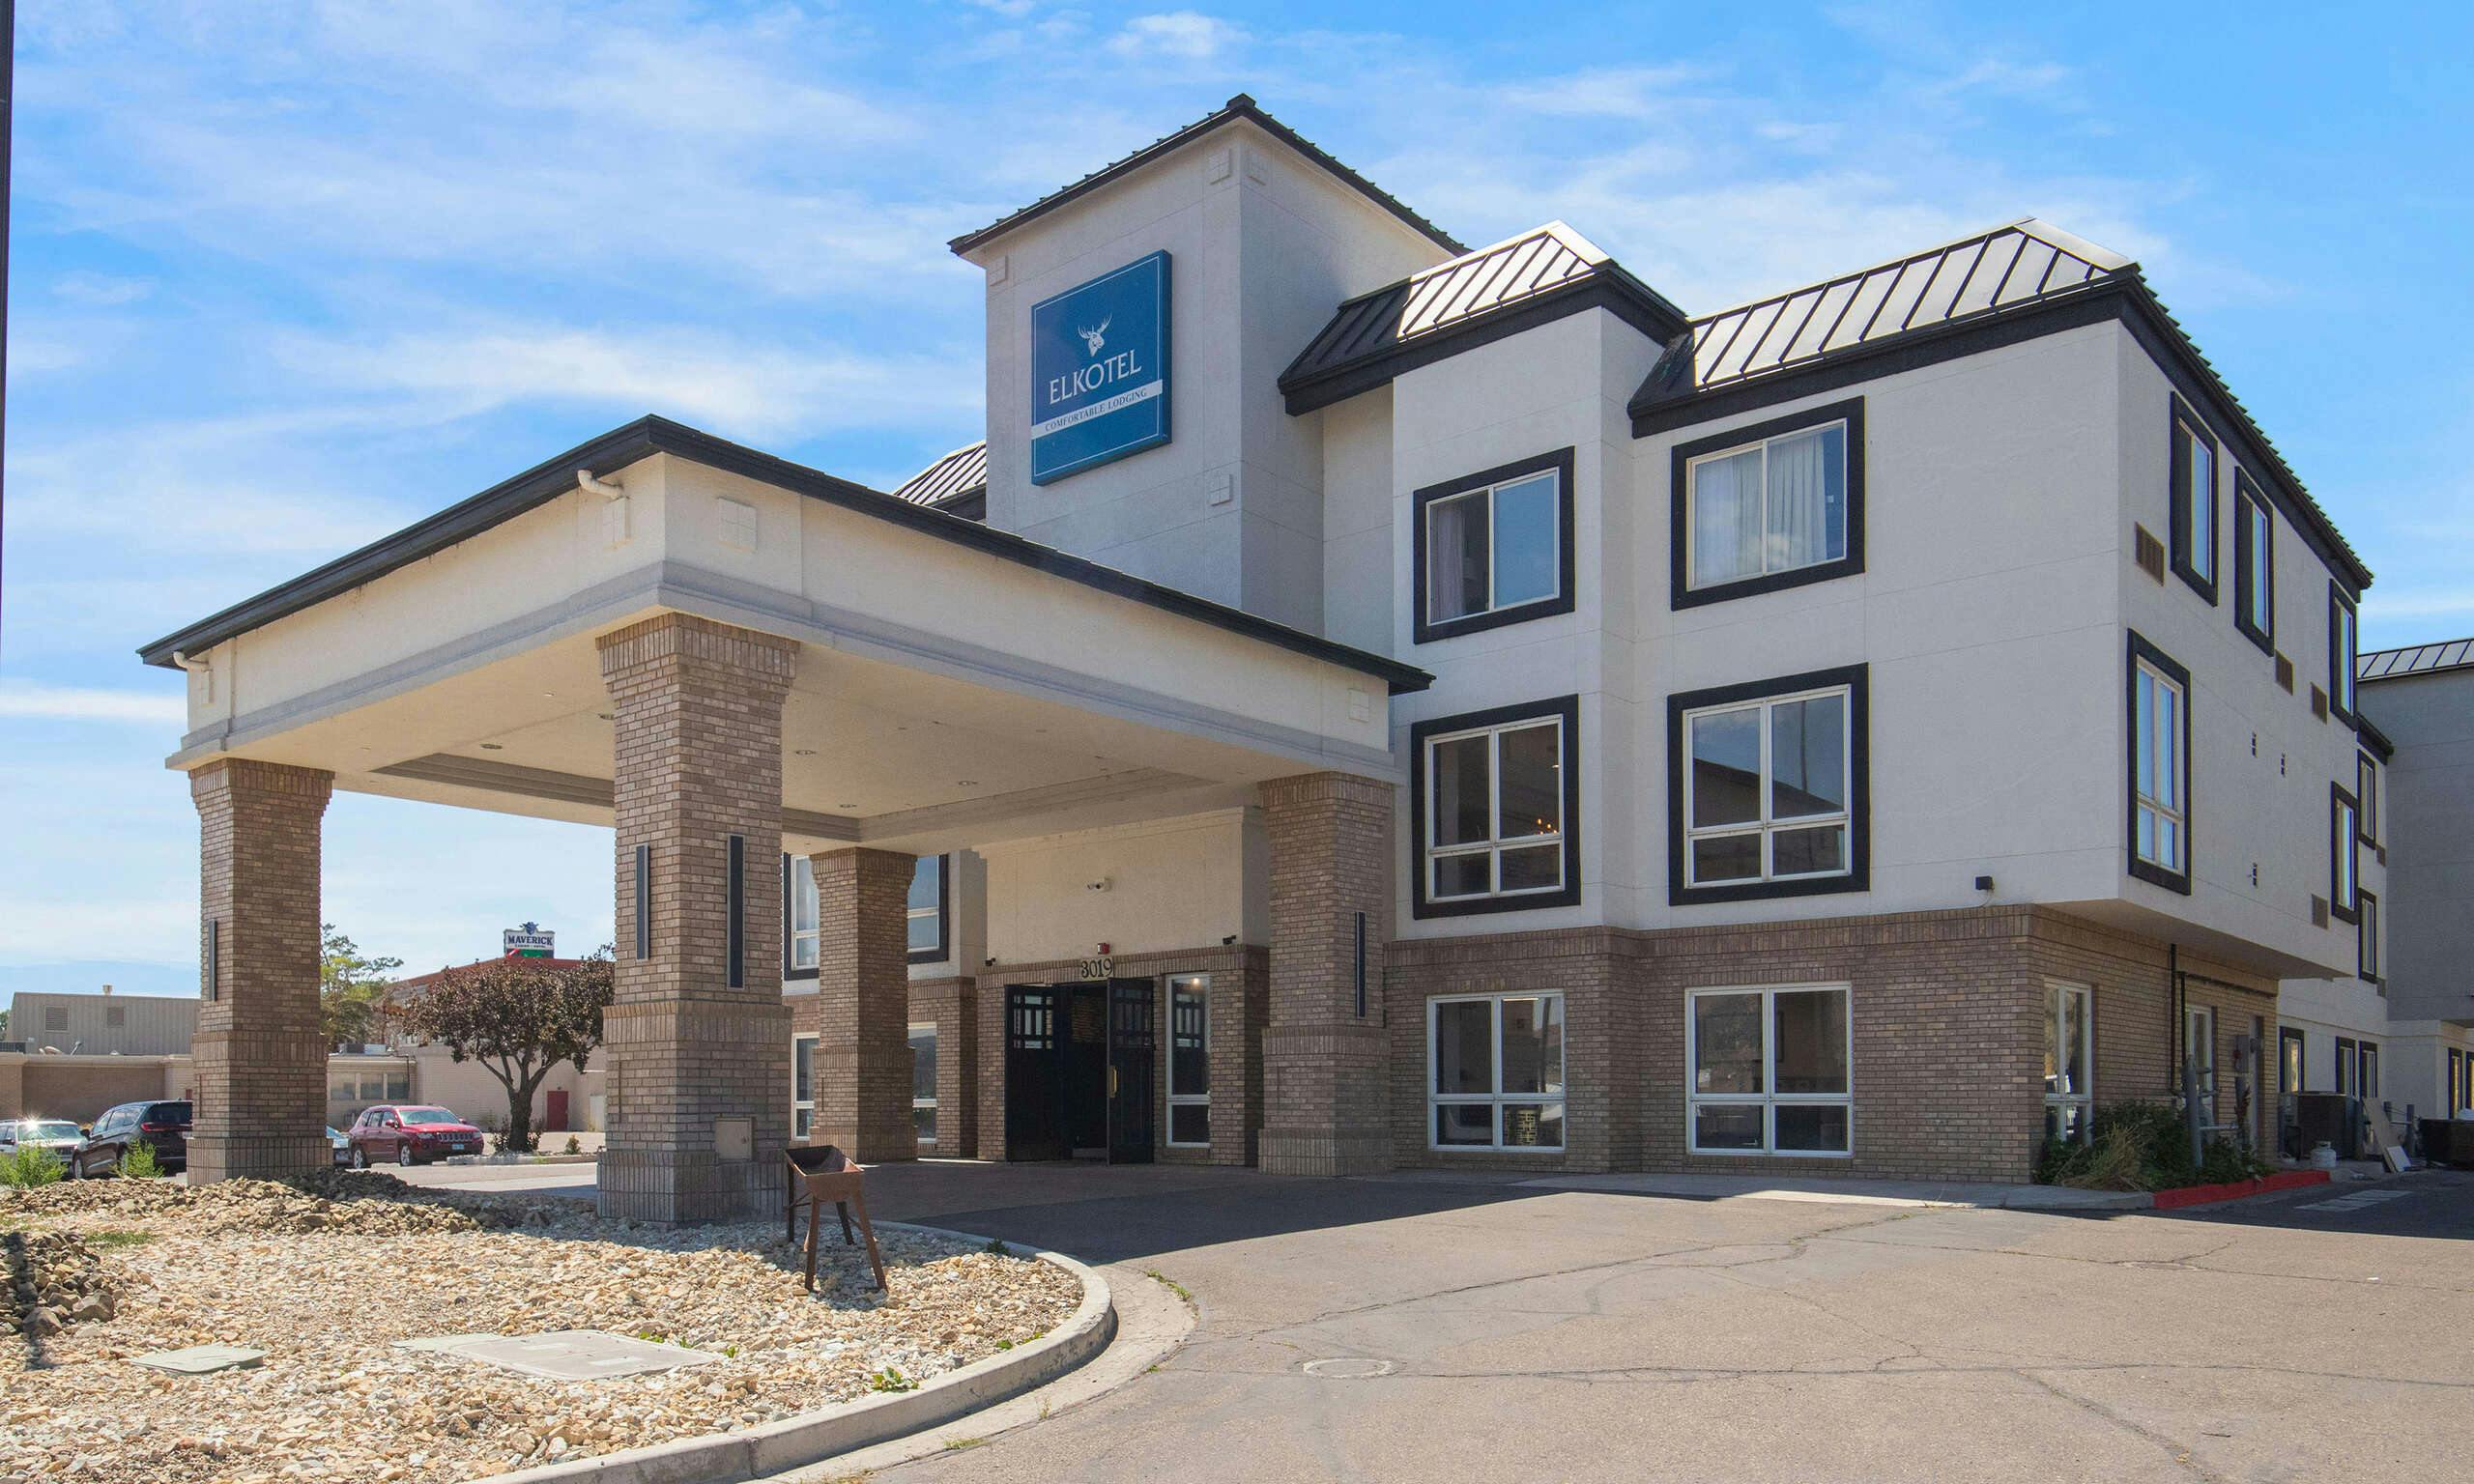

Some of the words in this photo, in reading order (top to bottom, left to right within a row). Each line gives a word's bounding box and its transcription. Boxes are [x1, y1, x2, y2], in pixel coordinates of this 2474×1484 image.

[1049, 349, 1142, 405] ELKOTEL
[1045, 402, 1106, 432] COMFORTABLE
[1108, 387, 1147, 411] LODGING
[507, 935, 553, 946] MAVERICK
[1081, 957, 1113, 979] 3019
